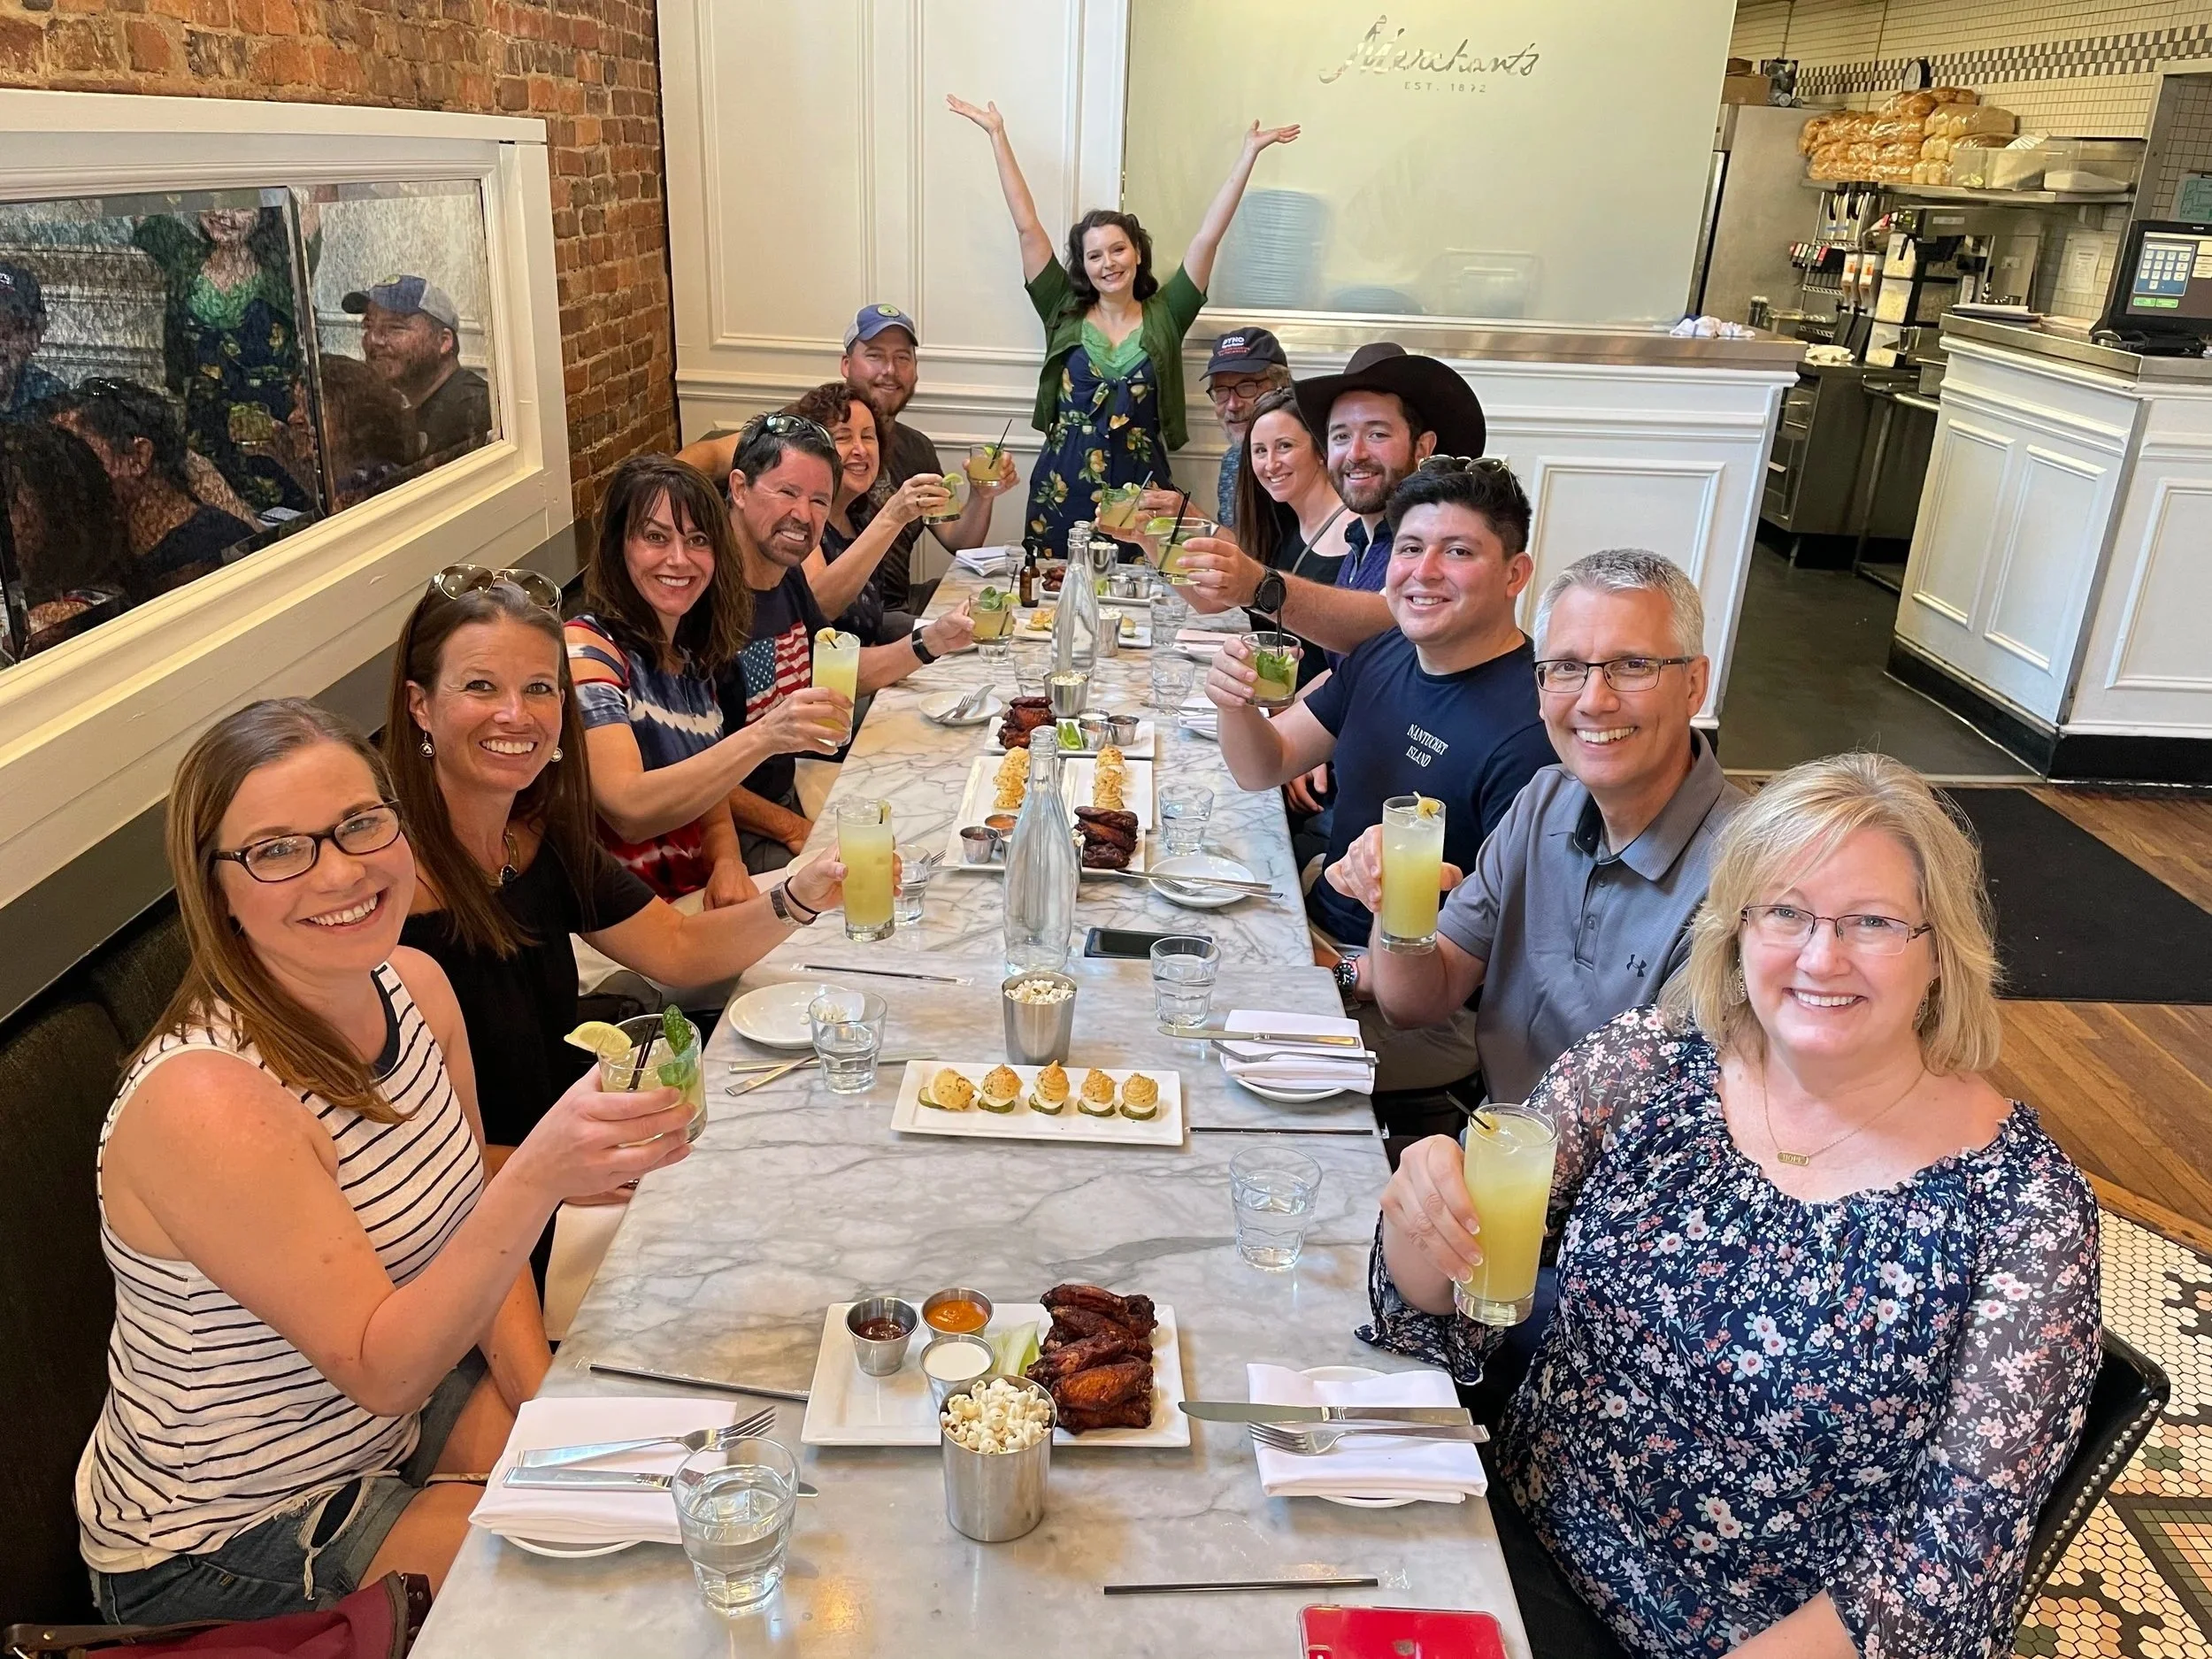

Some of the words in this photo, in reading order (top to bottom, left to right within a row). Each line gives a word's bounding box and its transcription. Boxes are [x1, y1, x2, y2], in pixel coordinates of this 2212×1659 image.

[1404, 81, 1440, 91] EST.
[1407, 723, 1449, 756] NANTUCKET
[1406, 745, 1432, 767] ISLAND
